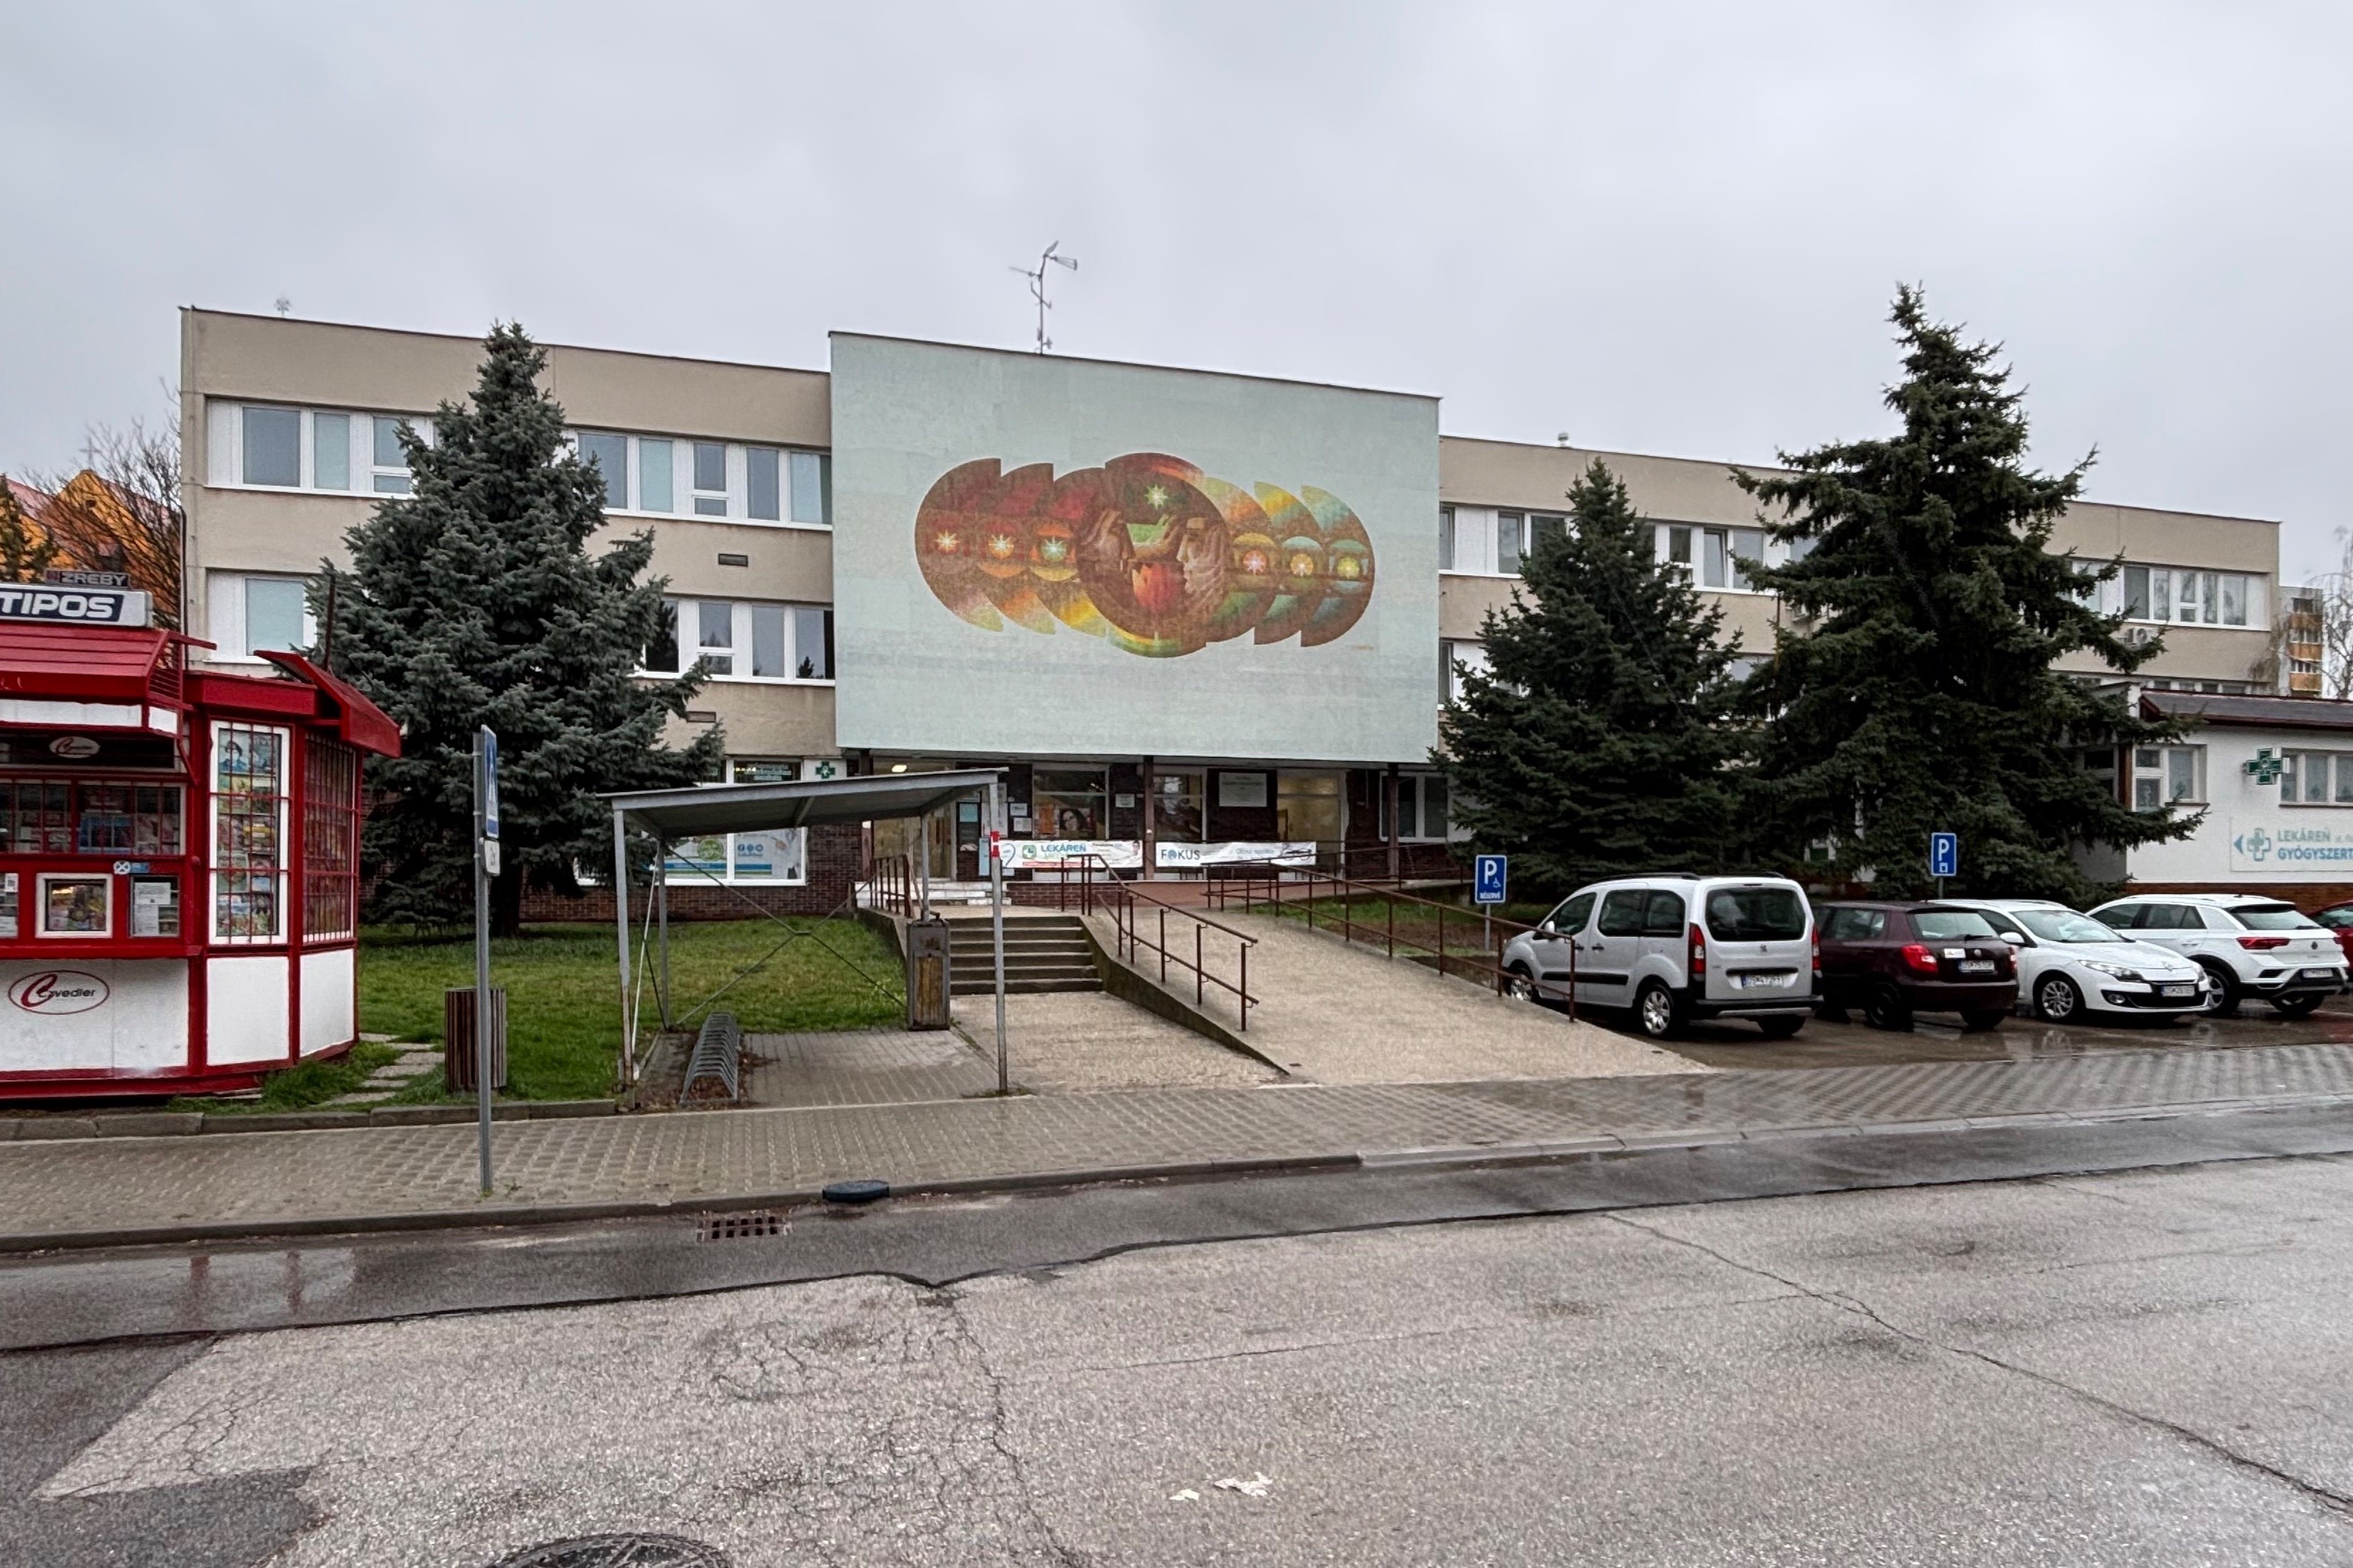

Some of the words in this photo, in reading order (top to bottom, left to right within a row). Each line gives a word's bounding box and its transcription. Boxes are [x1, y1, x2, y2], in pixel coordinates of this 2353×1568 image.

[0, 591, 116, 618] TIPOS
[1161, 850, 1201, 860] FOKUS
[1938, 838, 1950, 862] P
[1484, 860, 1497, 885] P
